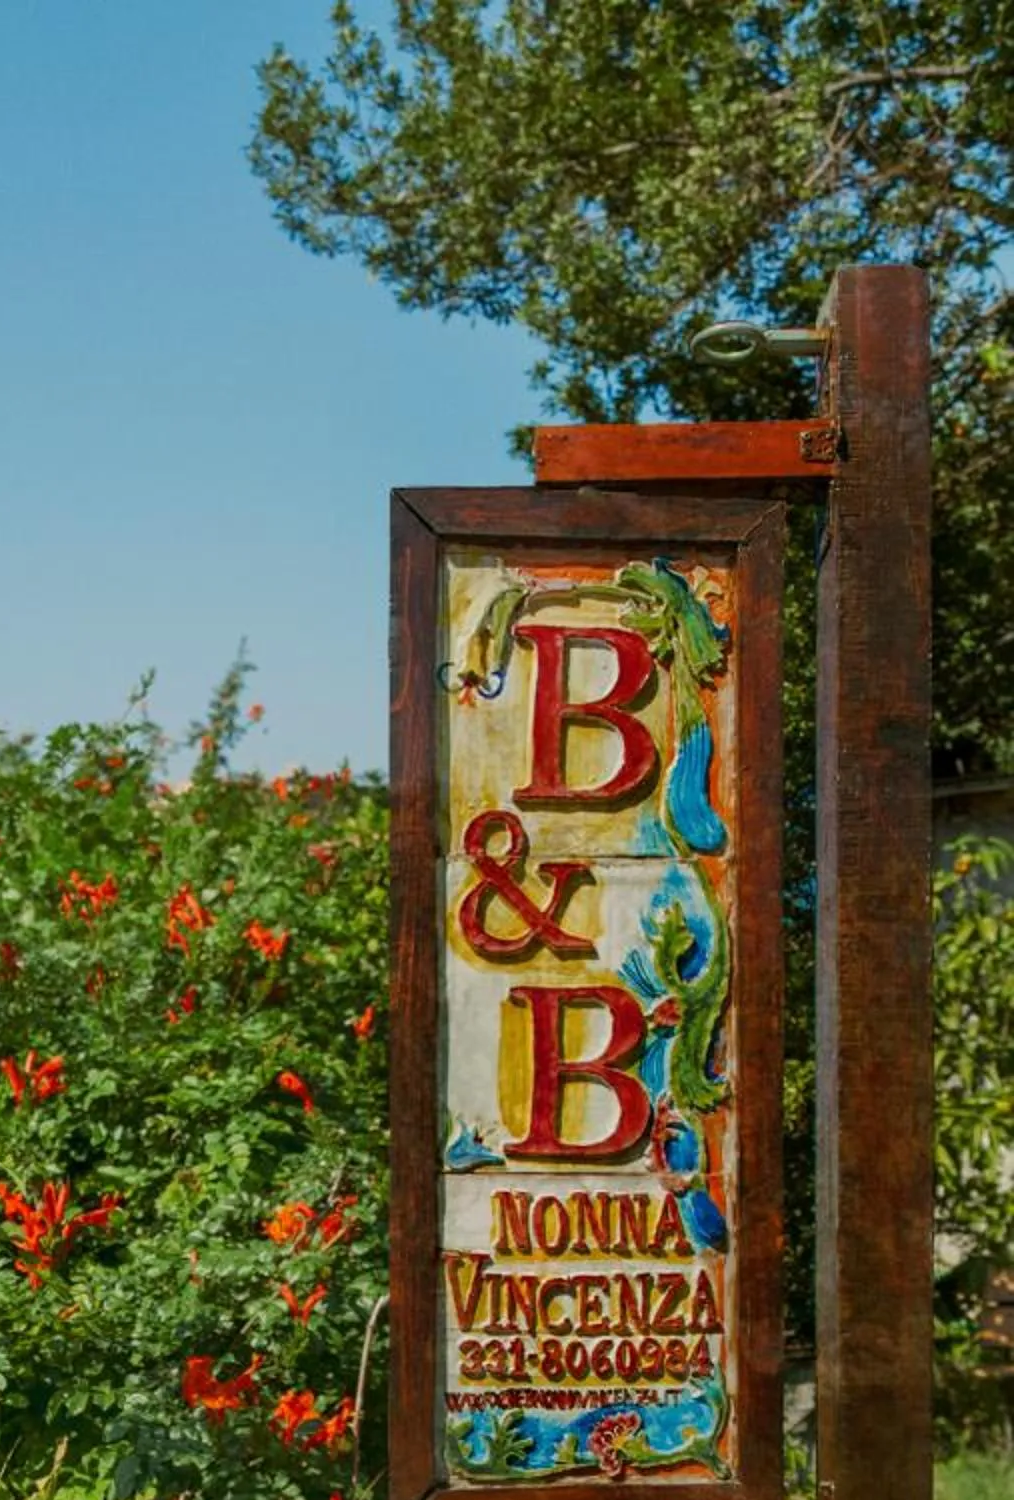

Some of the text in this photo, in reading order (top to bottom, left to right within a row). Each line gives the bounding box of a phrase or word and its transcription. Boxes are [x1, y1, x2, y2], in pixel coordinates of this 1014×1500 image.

[513, 624, 658, 804] B
[458, 809, 594, 959] &
[504, 984, 654, 1160] B
[491, 1190, 694, 1256] NONNA
